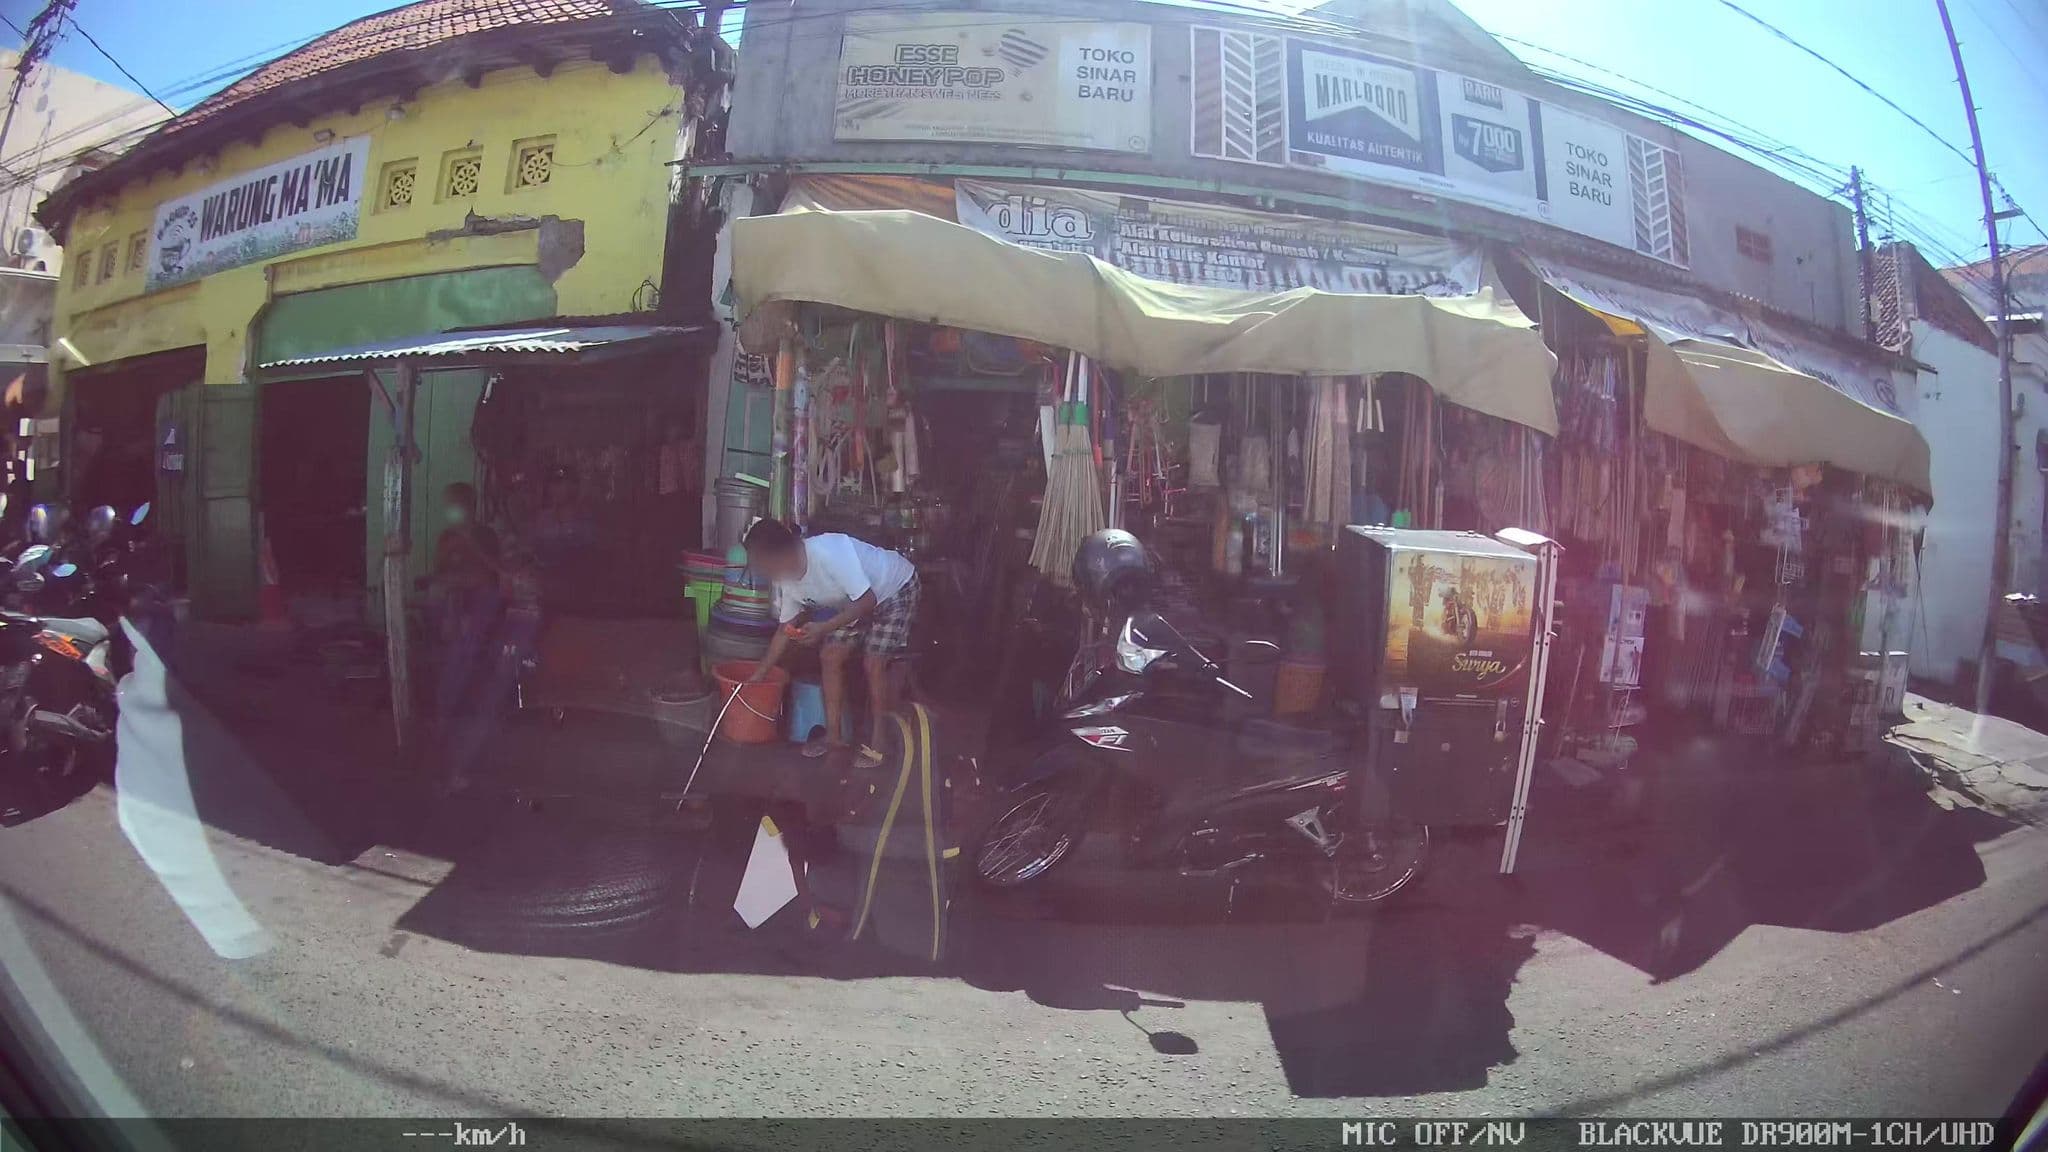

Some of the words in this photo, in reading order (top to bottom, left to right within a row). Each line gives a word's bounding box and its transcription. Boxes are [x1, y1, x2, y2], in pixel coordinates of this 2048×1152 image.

[896, 45, 959, 65] ESSE
[1079, 48, 1134, 64] TOKO
[1076, 65, 1136, 83] SINAR
[1078, 84, 1134, 102] BARU
[1307, 131, 1365, 152] KUALITAS
[1467, 120, 1516, 156] 7000
[1565, 141, 1608, 167] TOKO
[1566, 161, 1612, 188] SINAR
[1569, 181, 1611, 206] BARU
[200, 175, 278, 242] WARUNG
[1452, 652, 1506, 680] Surya
